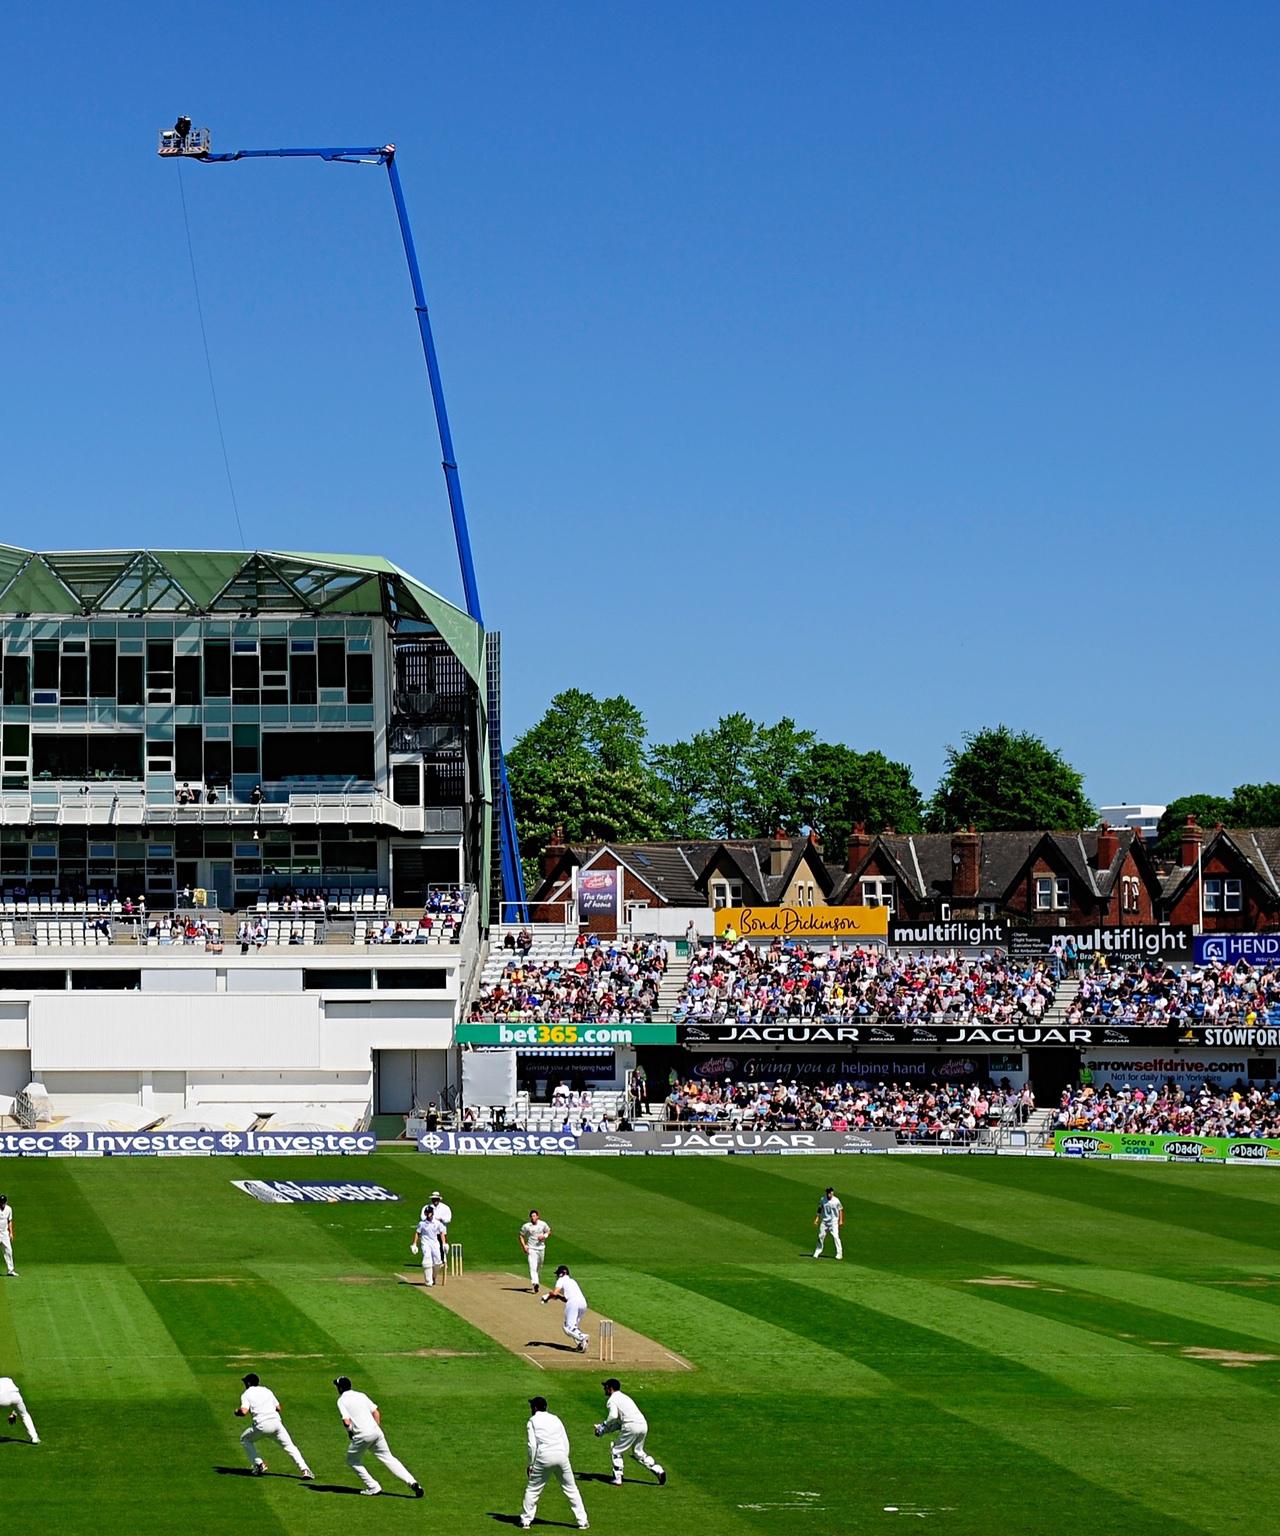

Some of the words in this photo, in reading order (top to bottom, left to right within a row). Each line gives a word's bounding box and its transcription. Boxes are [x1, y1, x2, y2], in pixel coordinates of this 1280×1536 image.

[740, 908, 781, 934] Bond
[780, 908, 860, 934] Dickinson
[894, 923, 1002, 945] multiflight
[1051, 928, 1187, 955] multiflight
[1231, 939, 1279, 954] HEND
[499, 1026, 632, 1043] bet365.com
[718, 1028, 859, 1041] JAGUAR
[946, 1029, 1092, 1042] JAGUAR
[1205, 1028, 1280, 1046] STOWFOR
[572, 1064, 595, 1072] helping
[796, 1063, 822, 1079] you
[826, 1064, 837, 1074] a
[841, 1061, 889, 1076] helping
[893, 1062, 926, 1074] hand
[1087, 1058, 1245, 1073] arrowselfdrive.com
[1140, 1073, 1159, 1082] daily
[1176, 1073, 1184, 1081] in
[1186, 1074, 1222, 1082] Yorkshire
[86, 1132, 215, 1150] Investec
[246, 1132, 375, 1150] Investec
[447, 1132, 576, 1150] Investec
[661, 1134, 816, 1147] JAGUAR
[1121, 1136, 1147, 1147] Score
[286, 1180, 399, 1201] Investec
